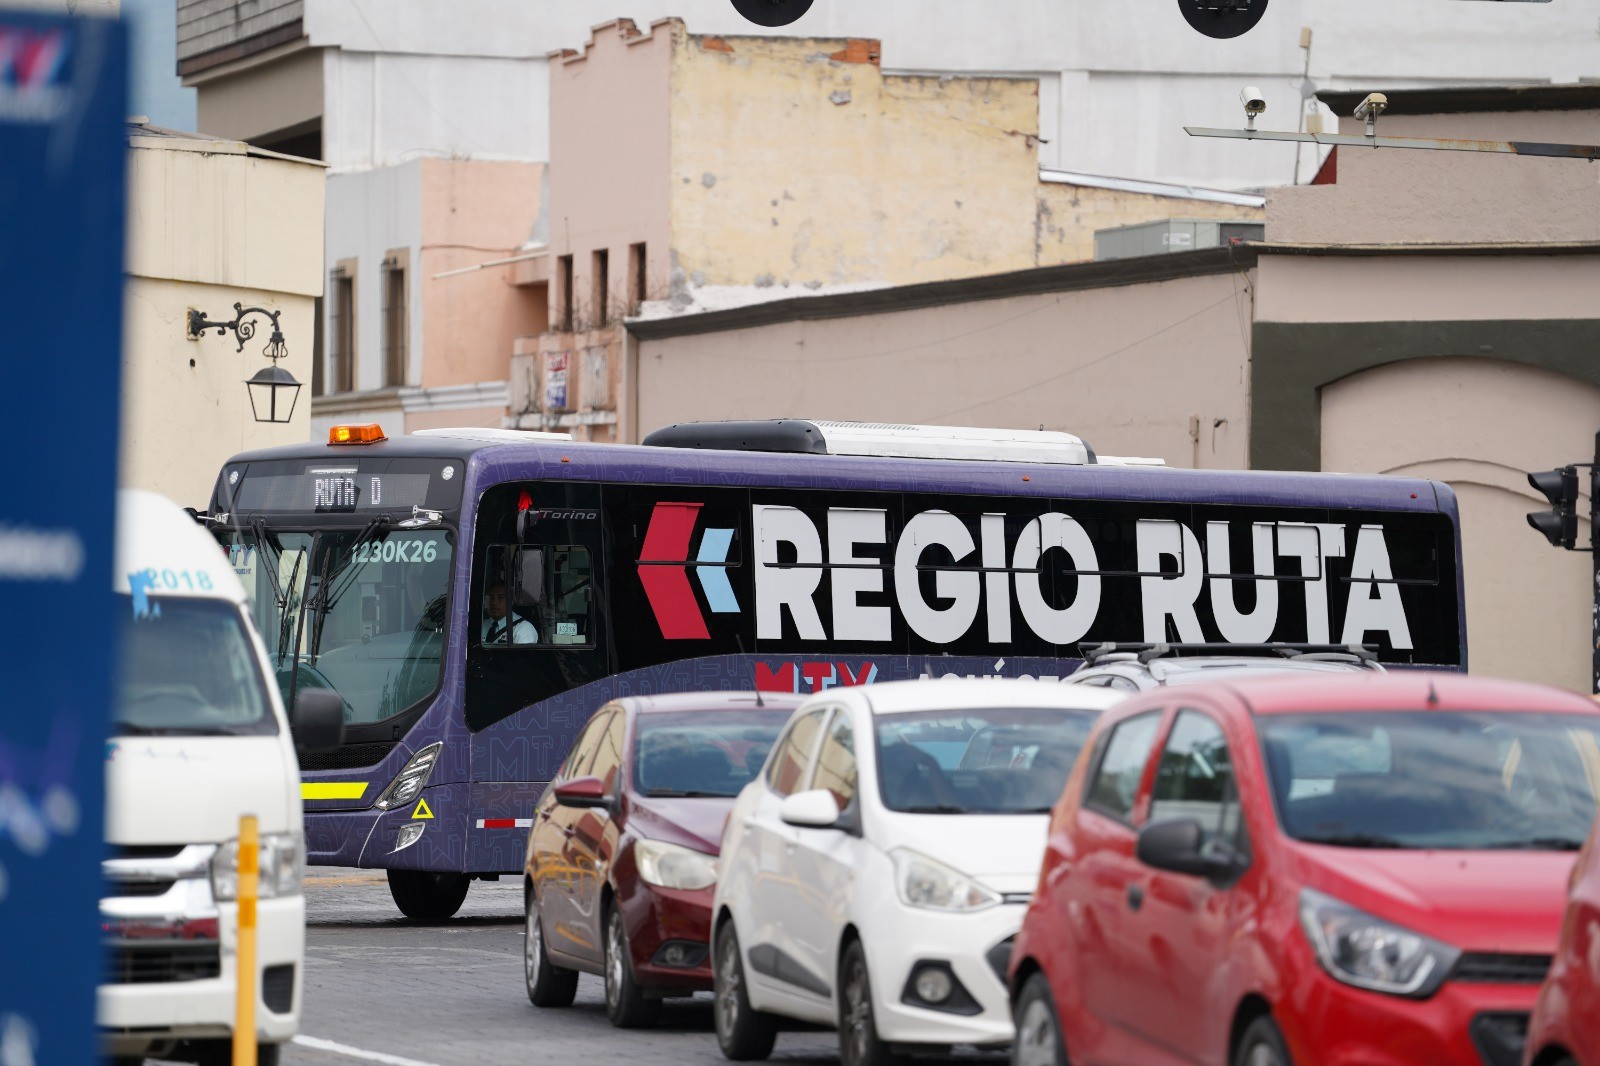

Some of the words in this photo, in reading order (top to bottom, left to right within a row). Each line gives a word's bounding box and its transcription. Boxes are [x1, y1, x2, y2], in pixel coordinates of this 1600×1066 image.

[315, 478, 355, 506] RUTA
[539, 509, 597, 520] Torino
[351, 539, 438, 564] 1230K26
[752, 503, 1101, 645] REGIO
[1136, 518, 1414, 650] RUTA
